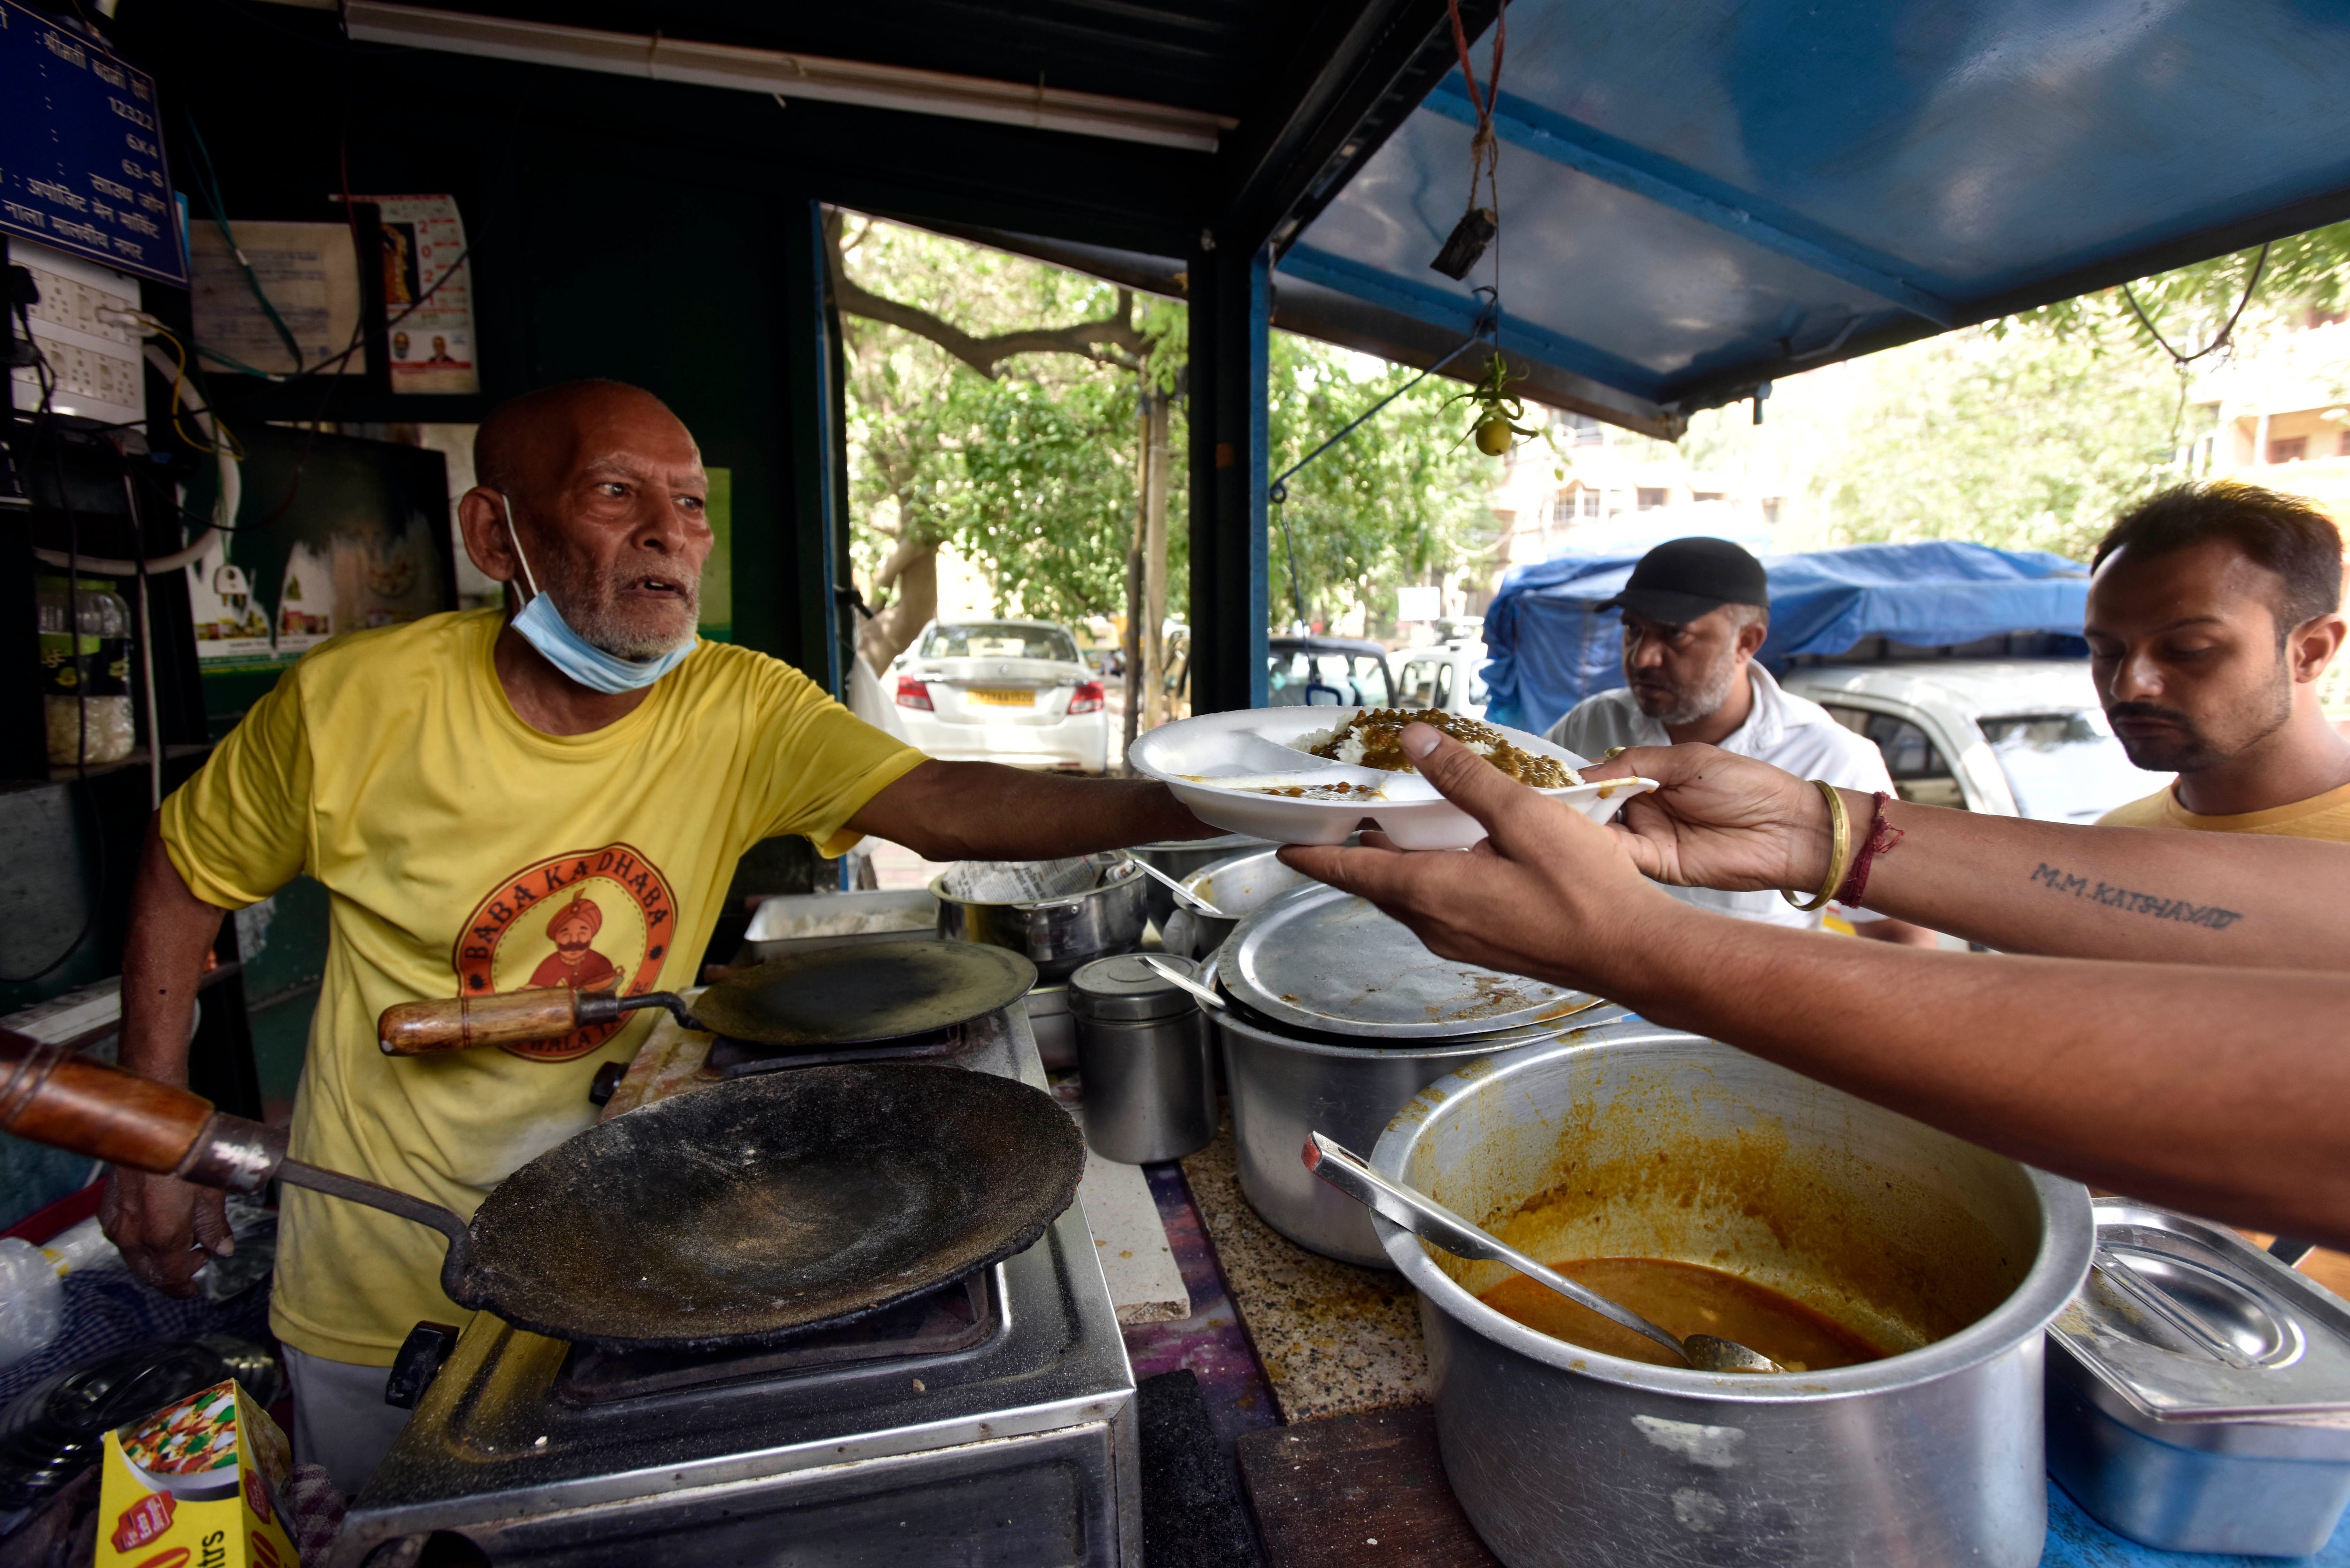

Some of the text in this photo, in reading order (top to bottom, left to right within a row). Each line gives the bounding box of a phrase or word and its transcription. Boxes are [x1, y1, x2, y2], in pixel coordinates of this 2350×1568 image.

[107, 96, 155, 131] 12322
[126, 133, 158, 159] 6X4
[122, 159, 164, 187] 63-S
[2, 199, 45, 228] नाला
[465, 852, 668, 959] BABA KA DHABA
